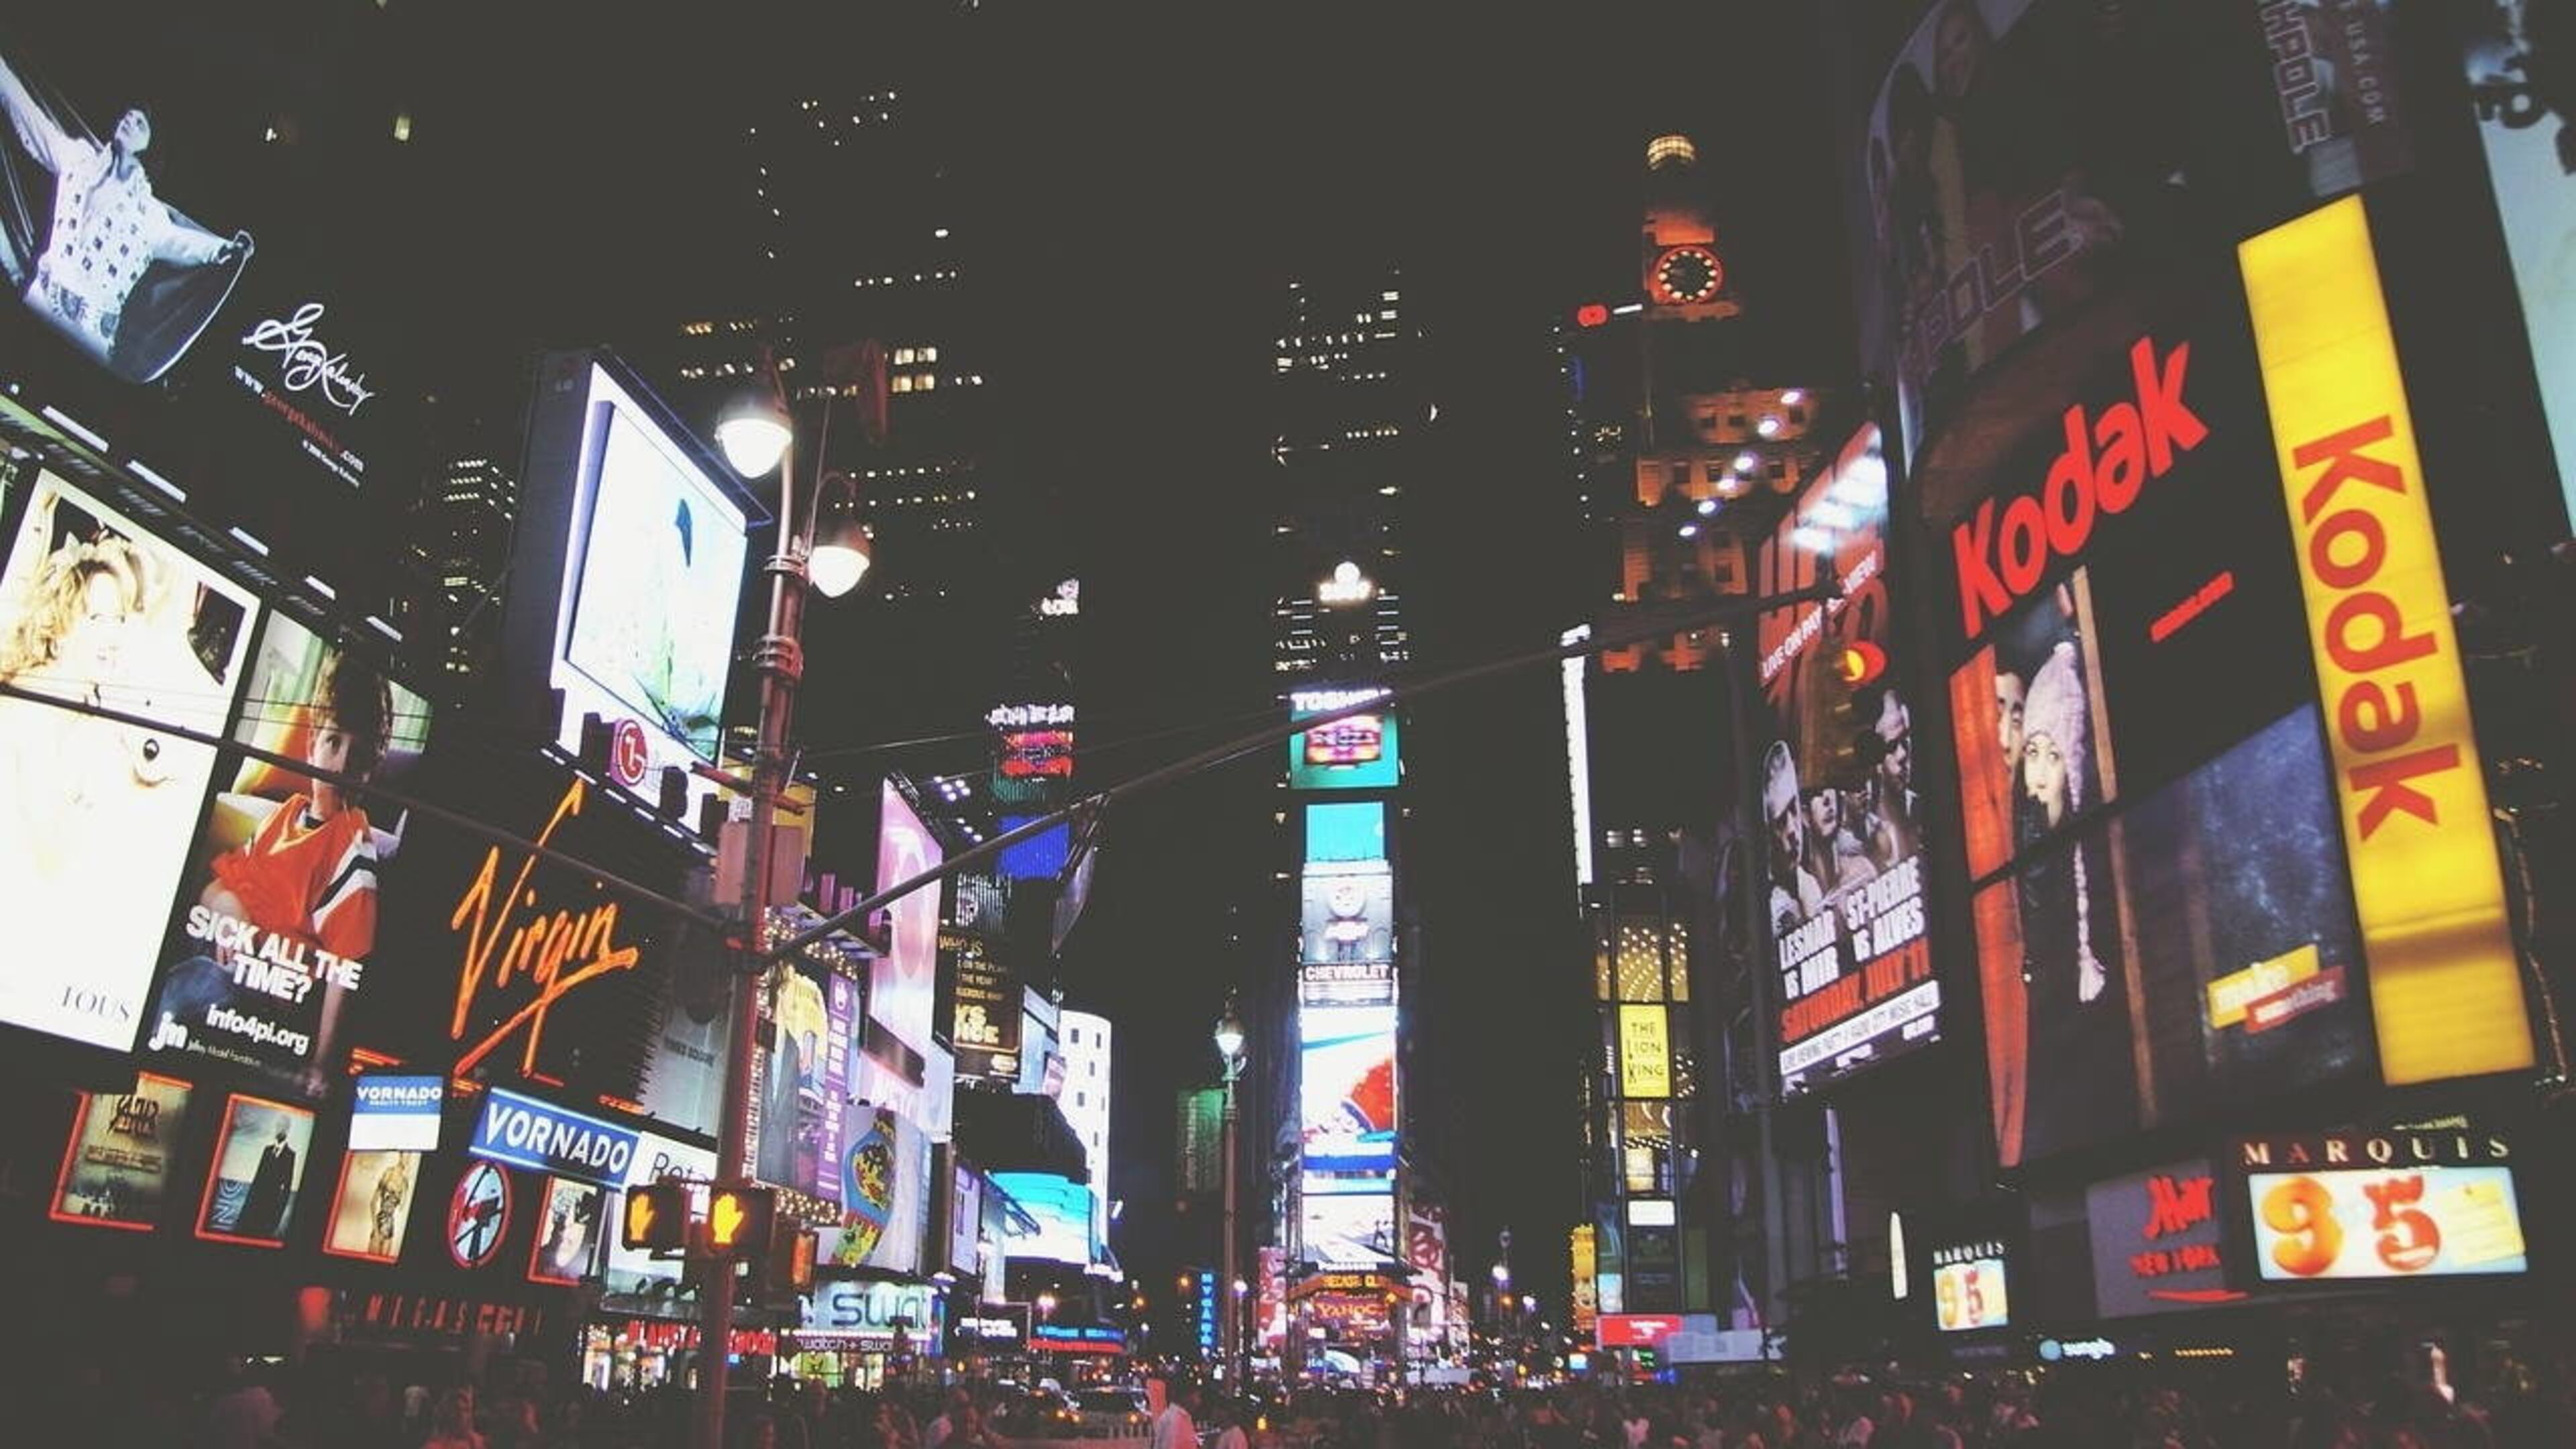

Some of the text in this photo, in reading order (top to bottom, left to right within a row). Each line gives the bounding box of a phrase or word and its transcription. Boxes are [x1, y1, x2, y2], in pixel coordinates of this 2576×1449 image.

[1953, 337, 2209, 639] Kodak
[2293, 415, 2461, 843] Kodak
[451, 777, 639, 1079] Virgin
[185, 905, 364, 991] SICK ALL THE
[233, 953, 313, 1004] TIME?
[1305, 964, 1390, 981] CHEVROLET
[62, 985, 131, 1022] TOUS
[149, 1012, 189, 1052] jm
[205, 1004, 310, 1057] info4pi.org
[1631, 1021, 1657, 1035] THE
[1627, 1039, 1662, 1060] LION
[1627, 1063, 1664, 1084] KING
[356, 1086, 443, 1101] VORNADO
[484, 1103, 631, 1174] VORNADO
[2245, 1136, 2510, 1166] MARQUIS
[1933, 1241, 2006, 1265] MARQUIS
